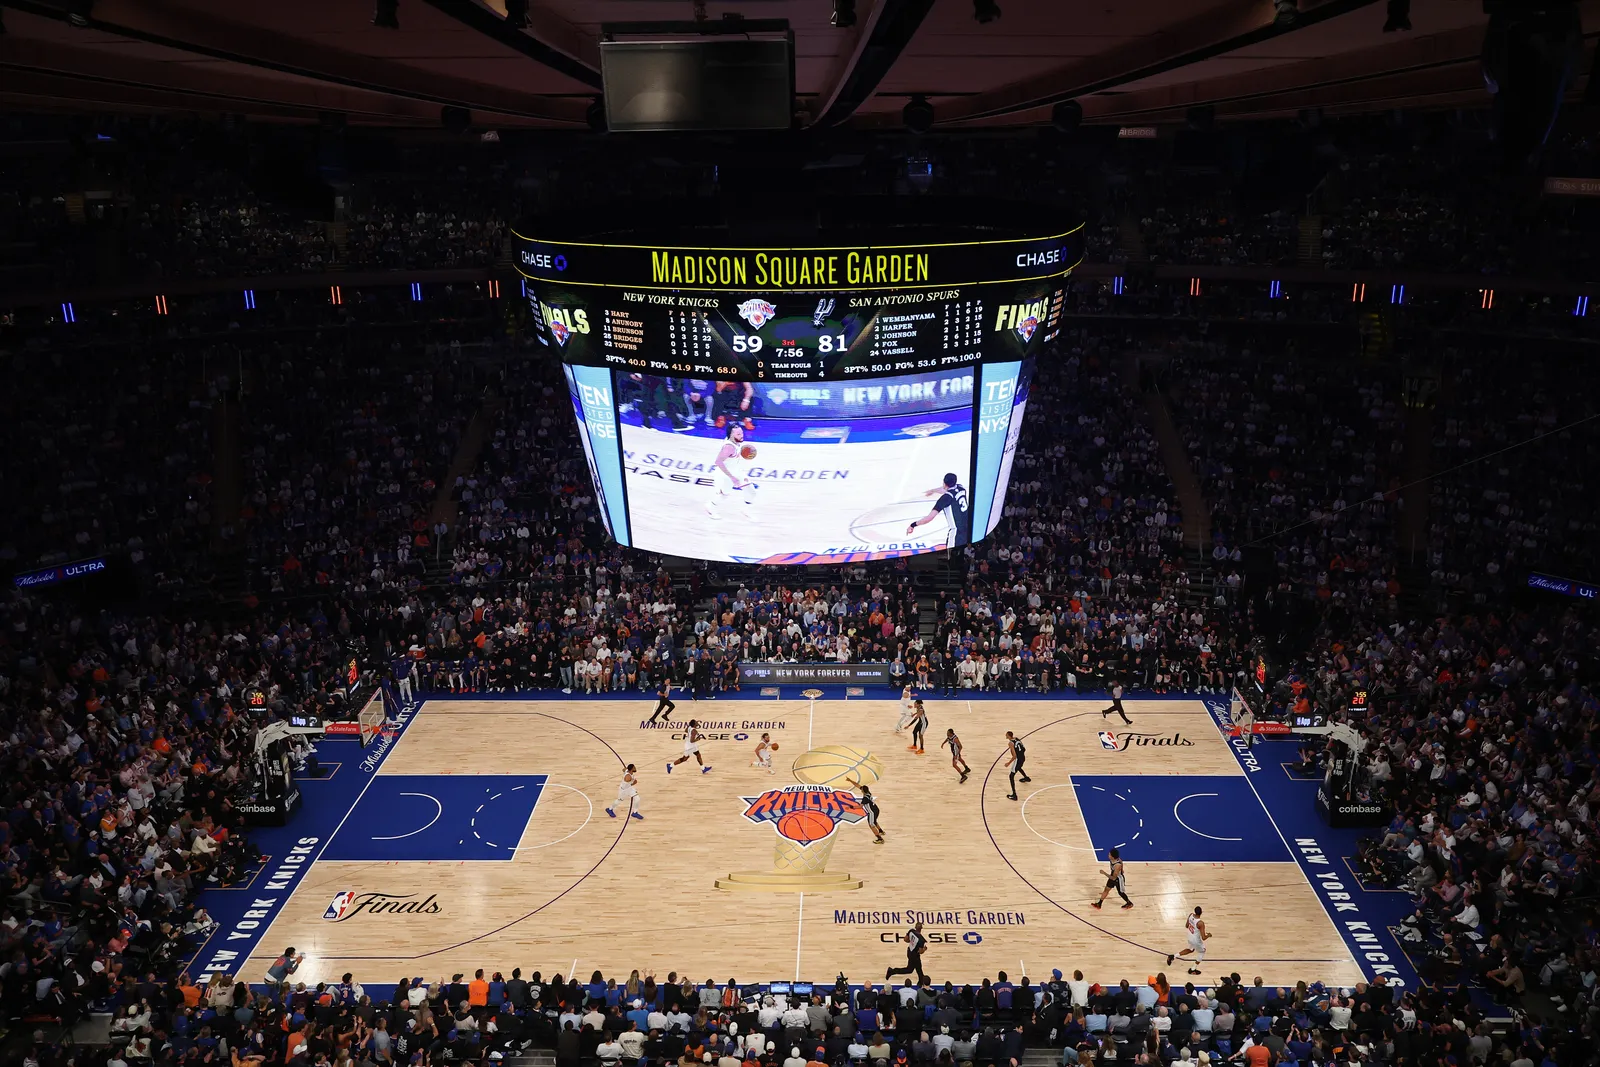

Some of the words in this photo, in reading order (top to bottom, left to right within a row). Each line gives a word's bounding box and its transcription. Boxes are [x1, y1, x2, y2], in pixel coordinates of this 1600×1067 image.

[521, 250, 551, 268] CHASE
[1016, 250, 1060, 267] CHASE
[652, 251, 746, 285] MADISON
[755, 252, 838, 285] SQUARE
[847, 251, 928, 284] GARDEN
[623, 292, 646, 303] NEW
[647, 294, 676, 305] YORK
[678, 297, 719, 308] KNICKS
[849, 298, 872, 307] SAN
[874, 294, 924, 306] ANTONIO
[926, 290, 960, 302] SPURS
[882, 313, 935, 323] WEMBANYAMA
[995, 296, 1049, 331] FINALS
[612, 319, 643, 328] ANUNOBY
[612, 326, 644, 335] BRUNSON
[613, 334, 642, 343] BRIDGES
[882, 330, 917, 339] JOHNSON
[614, 342, 637, 350] TOWNS
[732, 335, 763, 353] 59
[818, 334, 848, 352] 81
[882, 347, 914, 355] VASSELL
[776, 348, 803, 357] 7:56
[918, 359, 936, 367] 53.6
[959, 352, 981, 362] 100.0
[606, 355, 626, 364] 3PT%
[628, 359, 646, 367] 40.0
[650, 361, 668, 369] FG%
[672, 363, 691, 371] 41.9
[843, 386, 882, 405] NEW
[886, 381, 937, 402] YORK
[986, 374, 1018, 401] TEN
[747, 467, 850, 480] GARDEN
[823, 544, 871, 554] NEW
[876, 542, 928, 550] YORK
[66, 561, 105, 576] ULTRA
[1528, 576, 1569, 592] Michelob
[776, 669, 792, 677] NEW
[794, 669, 815, 677] YORK
[817, 669, 850, 677] FOREVER
[696, 720, 737, 729] SQUARE
[742, 720, 786, 730] GARDEN
[1113, 732, 1195, 752] Finals
[1232, 739, 1261, 772] ULTRA
[744, 790, 868, 816] KNICKS
[1339, 805, 1381, 813] coinbase
[226, 898, 277, 941] YORK
[264, 837, 319, 890] KNICKS
[329, 893, 443, 922] Finals
[1295, 838, 1330, 865] NEW
[1316, 872, 1360, 912] YORK
[1345, 921, 1406, 987] KNICKS
[834, 910, 901, 924] MADISON
[906, 910, 962, 925] SQUARE
[968, 910, 1025, 925] GARDEN
[880, 933, 958, 943] CHSE
